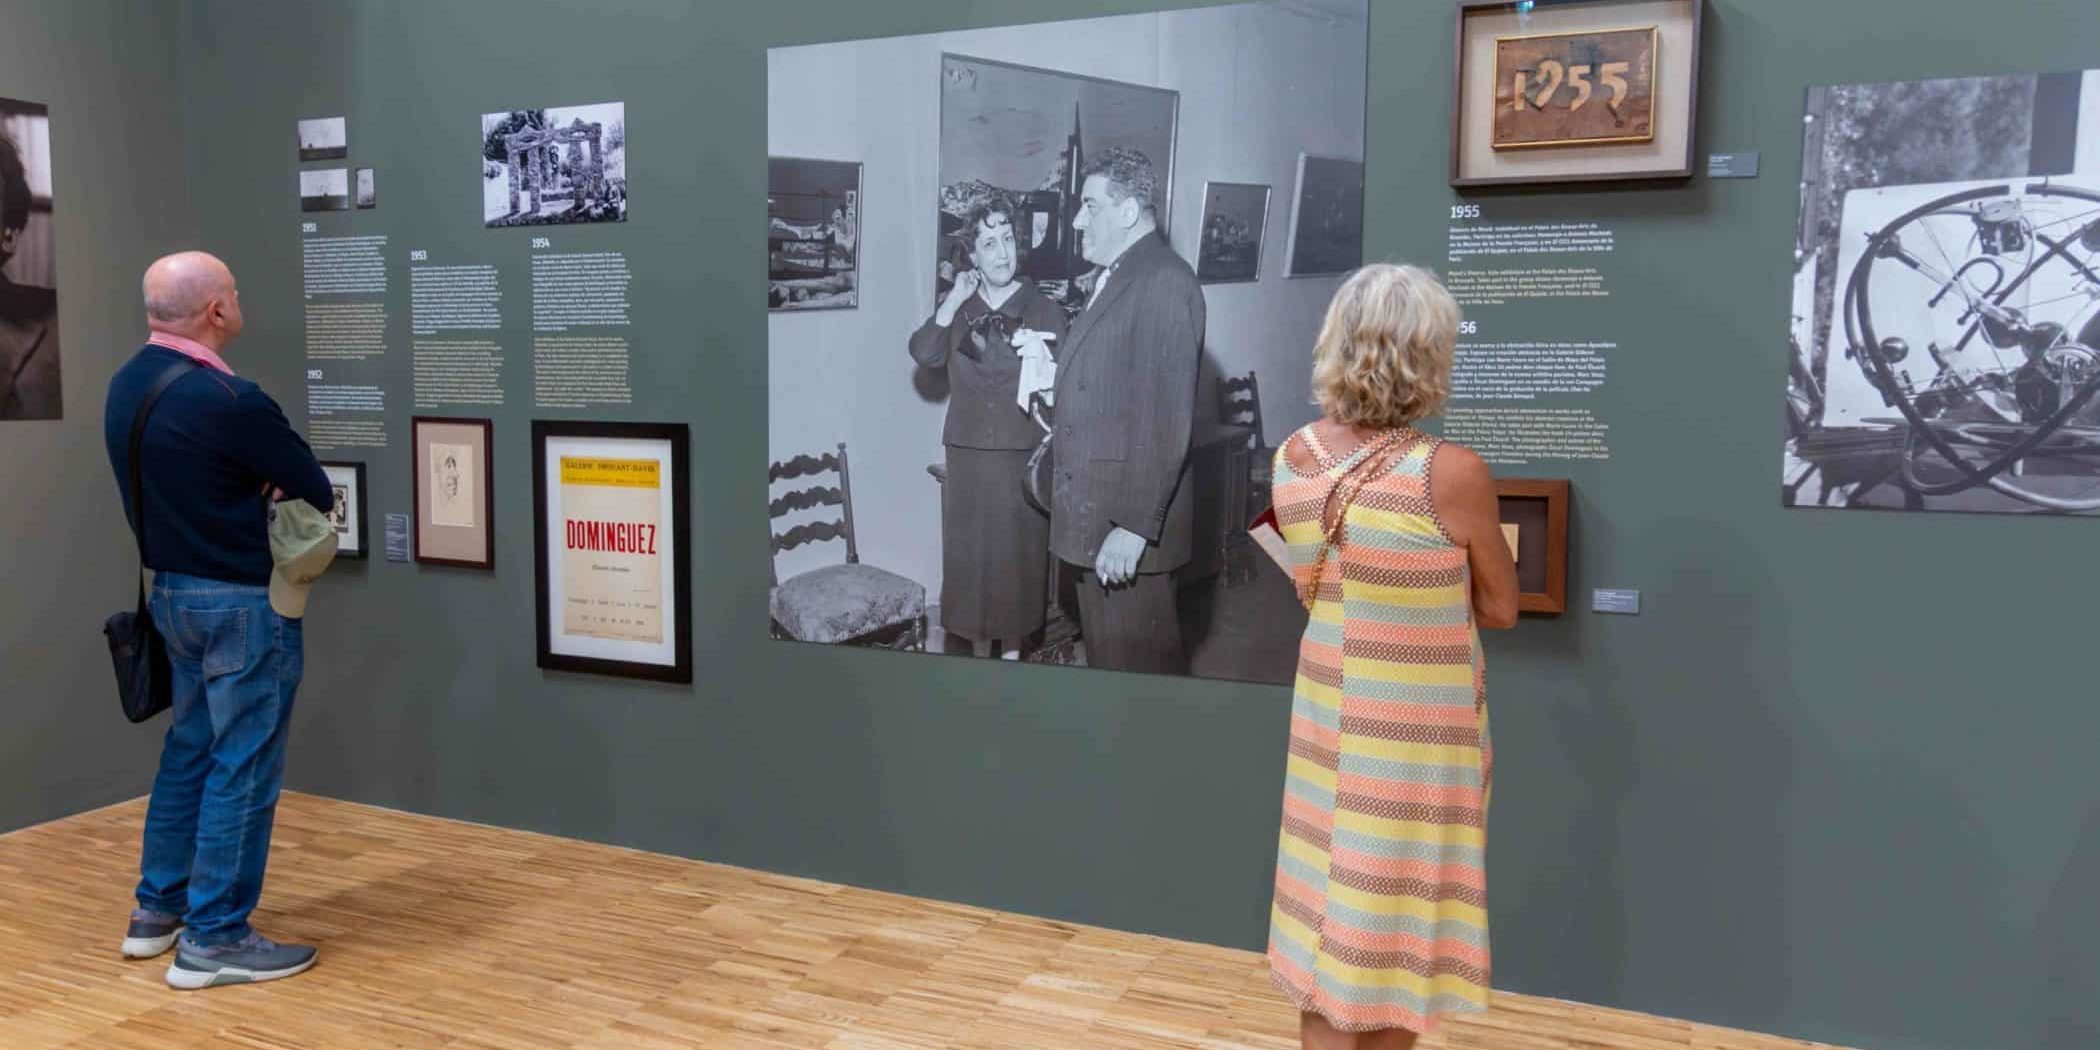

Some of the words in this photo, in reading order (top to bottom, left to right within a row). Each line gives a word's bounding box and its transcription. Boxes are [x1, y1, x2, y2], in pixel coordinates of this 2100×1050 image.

[1513, 60, 1629, 112] 1955
[1451, 205, 1480, 218] 1955
[567, 520, 656, 554] DOMINGUEZ
